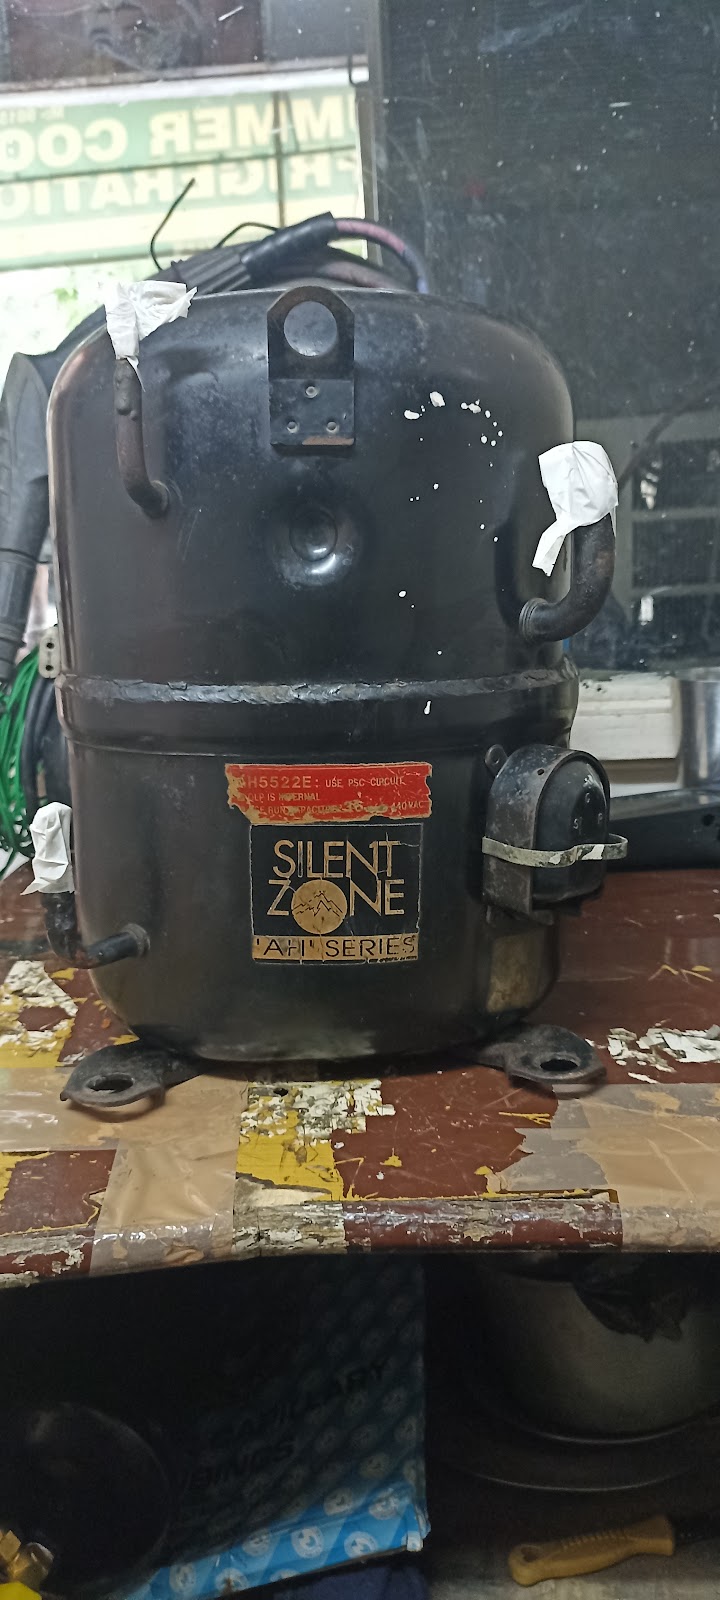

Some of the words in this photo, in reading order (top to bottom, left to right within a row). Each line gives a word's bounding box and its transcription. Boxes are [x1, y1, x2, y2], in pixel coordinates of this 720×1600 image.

[325, 778, 343, 788] USE
[348, 777, 366, 788] PSC
[267, 793, 276, 802] IS
[272, 839, 401, 878] SILENT
[266, 878, 405, 935] ZONE
[325, 934, 416, 957] SERIES
